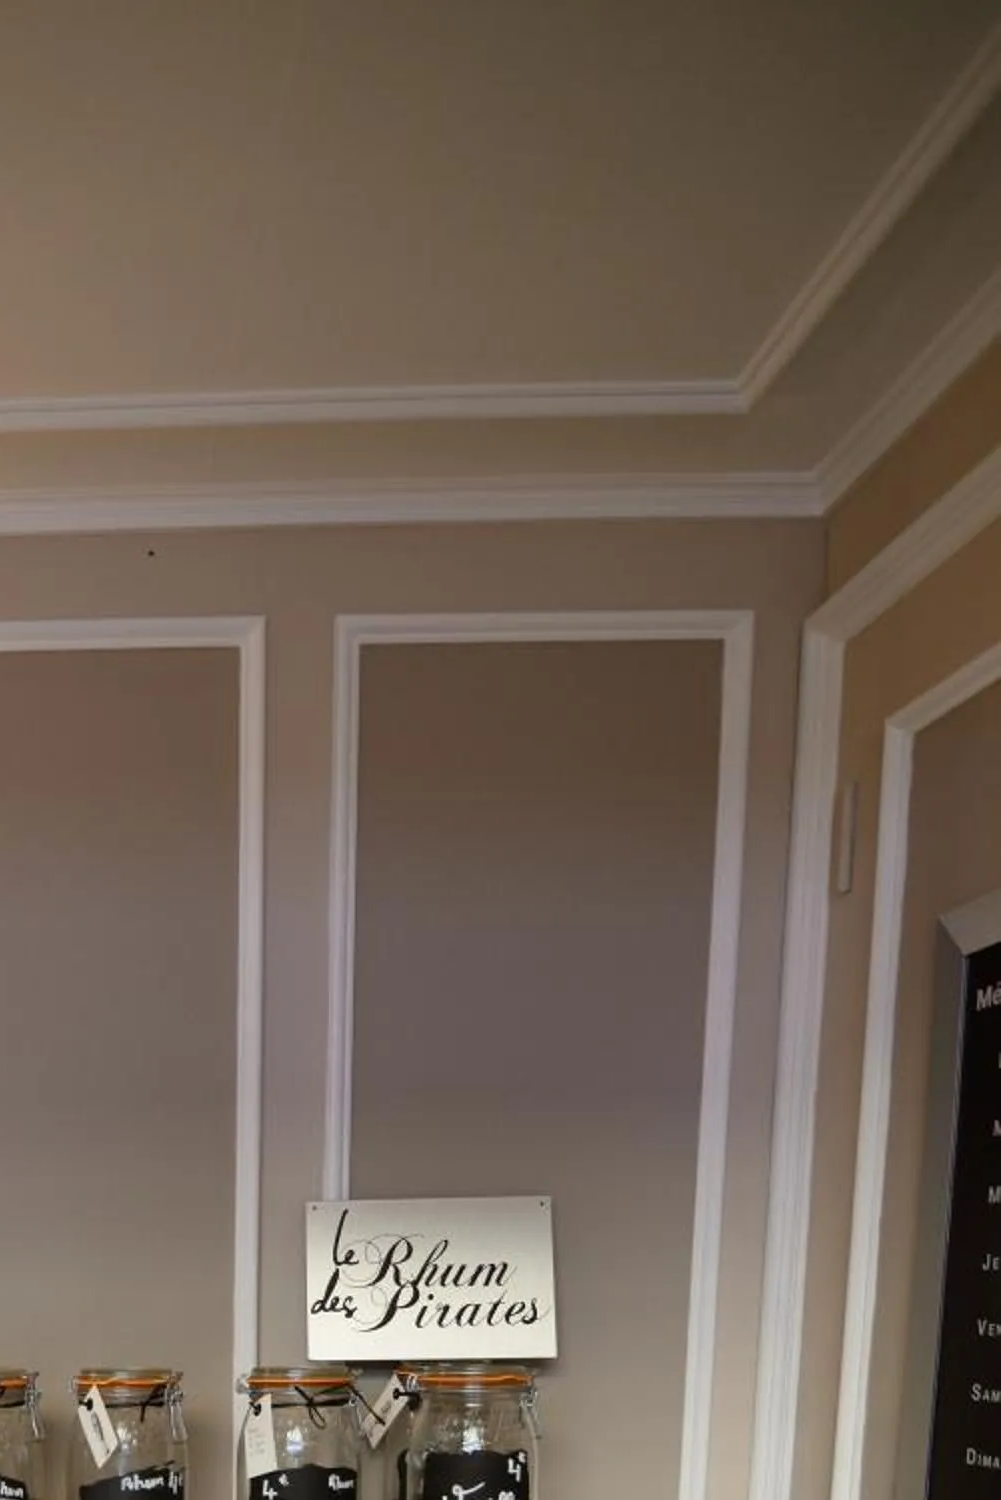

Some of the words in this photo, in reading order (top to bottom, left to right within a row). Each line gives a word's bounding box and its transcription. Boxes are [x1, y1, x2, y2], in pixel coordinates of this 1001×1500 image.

[349, 1233, 515, 1288] Rhum
[311, 1268, 358, 1318] des
[351, 1282, 548, 1333] Pirates
